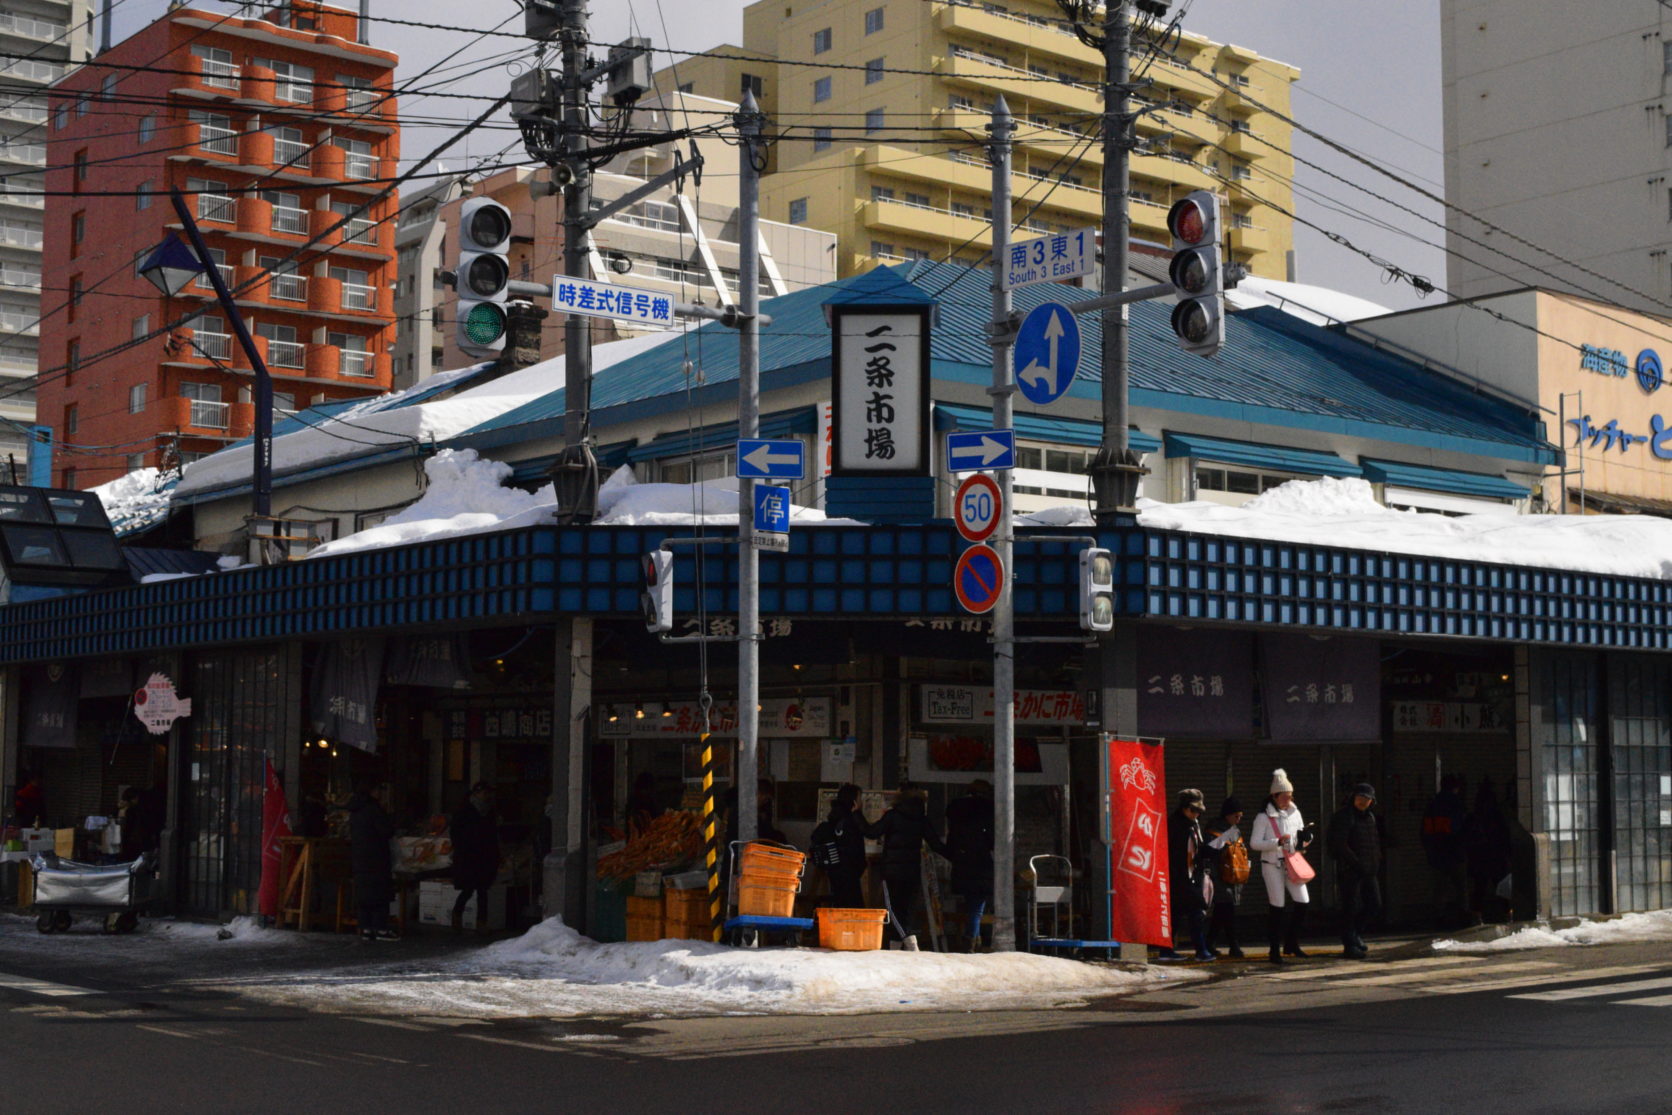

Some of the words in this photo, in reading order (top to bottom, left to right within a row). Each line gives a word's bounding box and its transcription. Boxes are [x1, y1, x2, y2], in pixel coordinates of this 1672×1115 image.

[1010, 231, 1084, 270] 南3東1
[1008, 268, 1037, 285] South
[1040, 265, 1047, 278] 3
[1052, 260, 1075, 276] East
[1079, 258, 1084, 271] 1
[558, 283, 670, 320] 時差式信号機
[864, 325, 897, 460] 二条市場
[759, 493, 785, 524] 停
[964, 492, 991, 523] 50
[1147, 673, 1225, 697] 二条市場
[1286, 682, 1354, 704] 二条市場
[931, 700, 971, 716] Tax-Free
